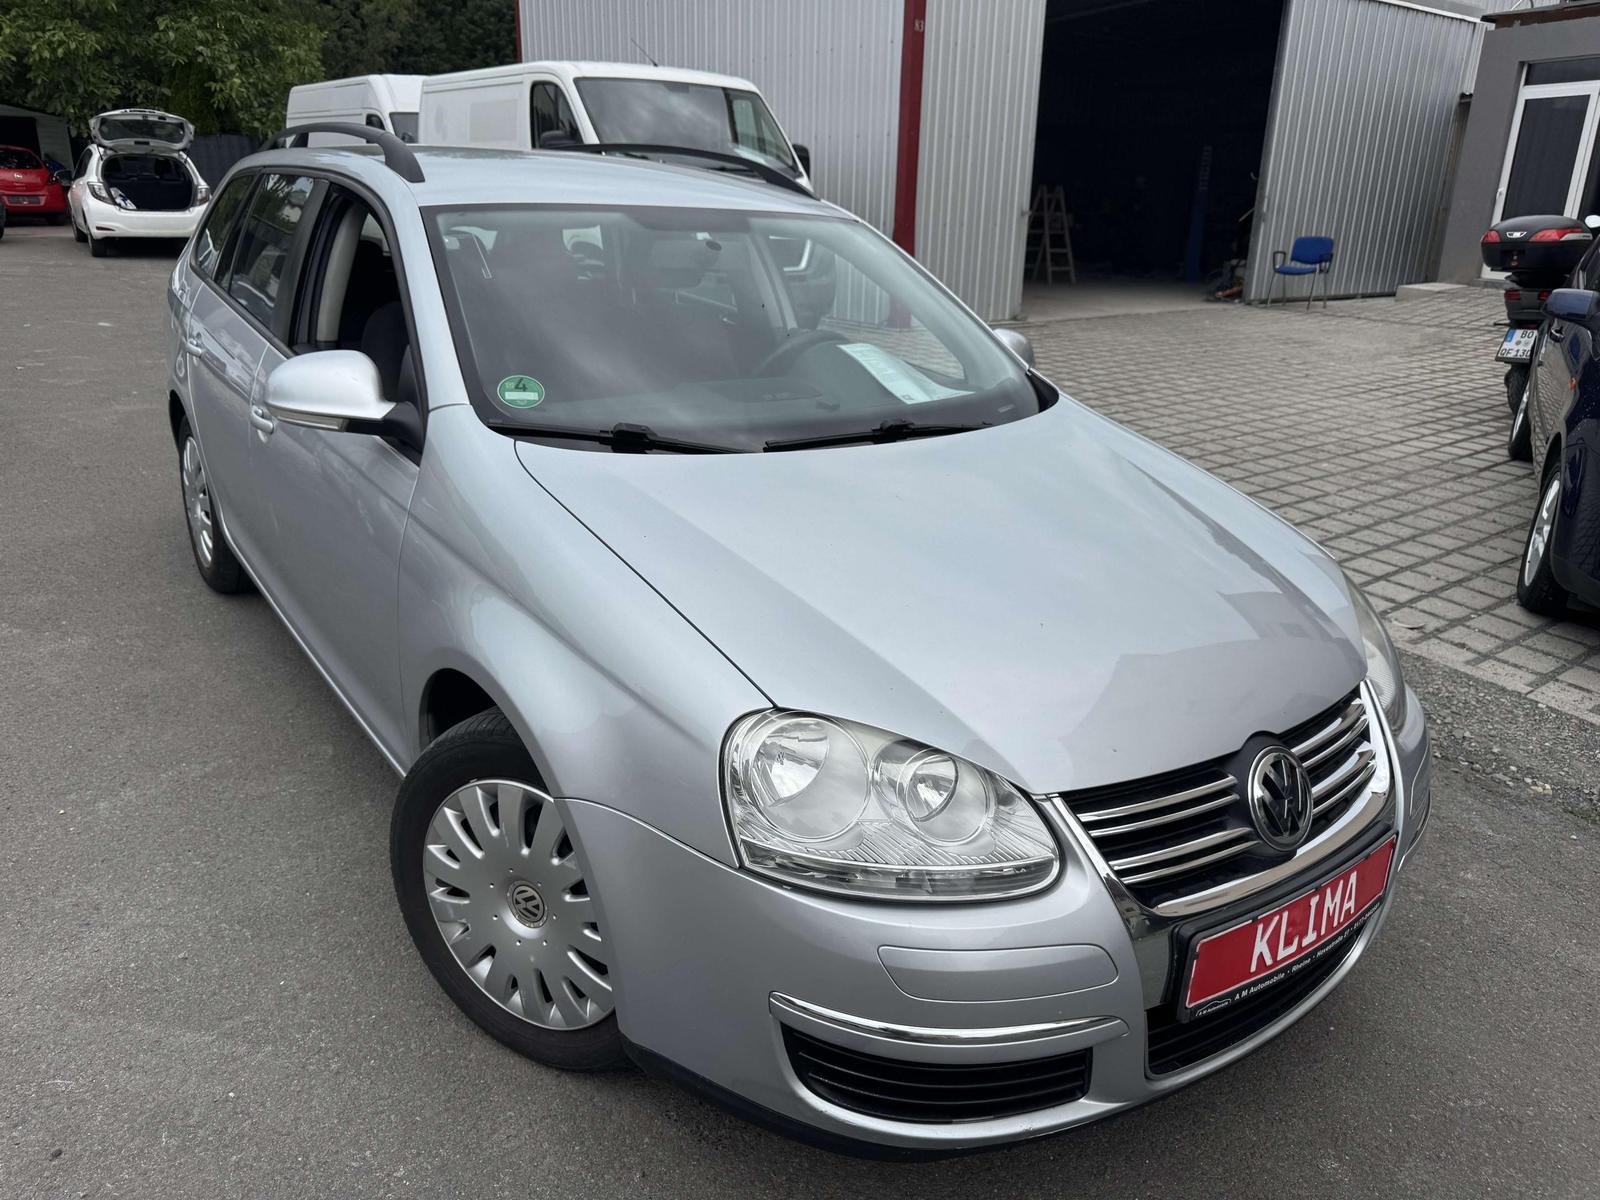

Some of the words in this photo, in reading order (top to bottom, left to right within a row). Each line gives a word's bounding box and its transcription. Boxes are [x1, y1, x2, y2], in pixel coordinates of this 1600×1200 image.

[1520, 330, 1535, 339] BO
[514, 377, 528, 392] 4
[1250, 870, 1357, 973] KLIMA
[1249, 972, 1285, 994] Automobile
